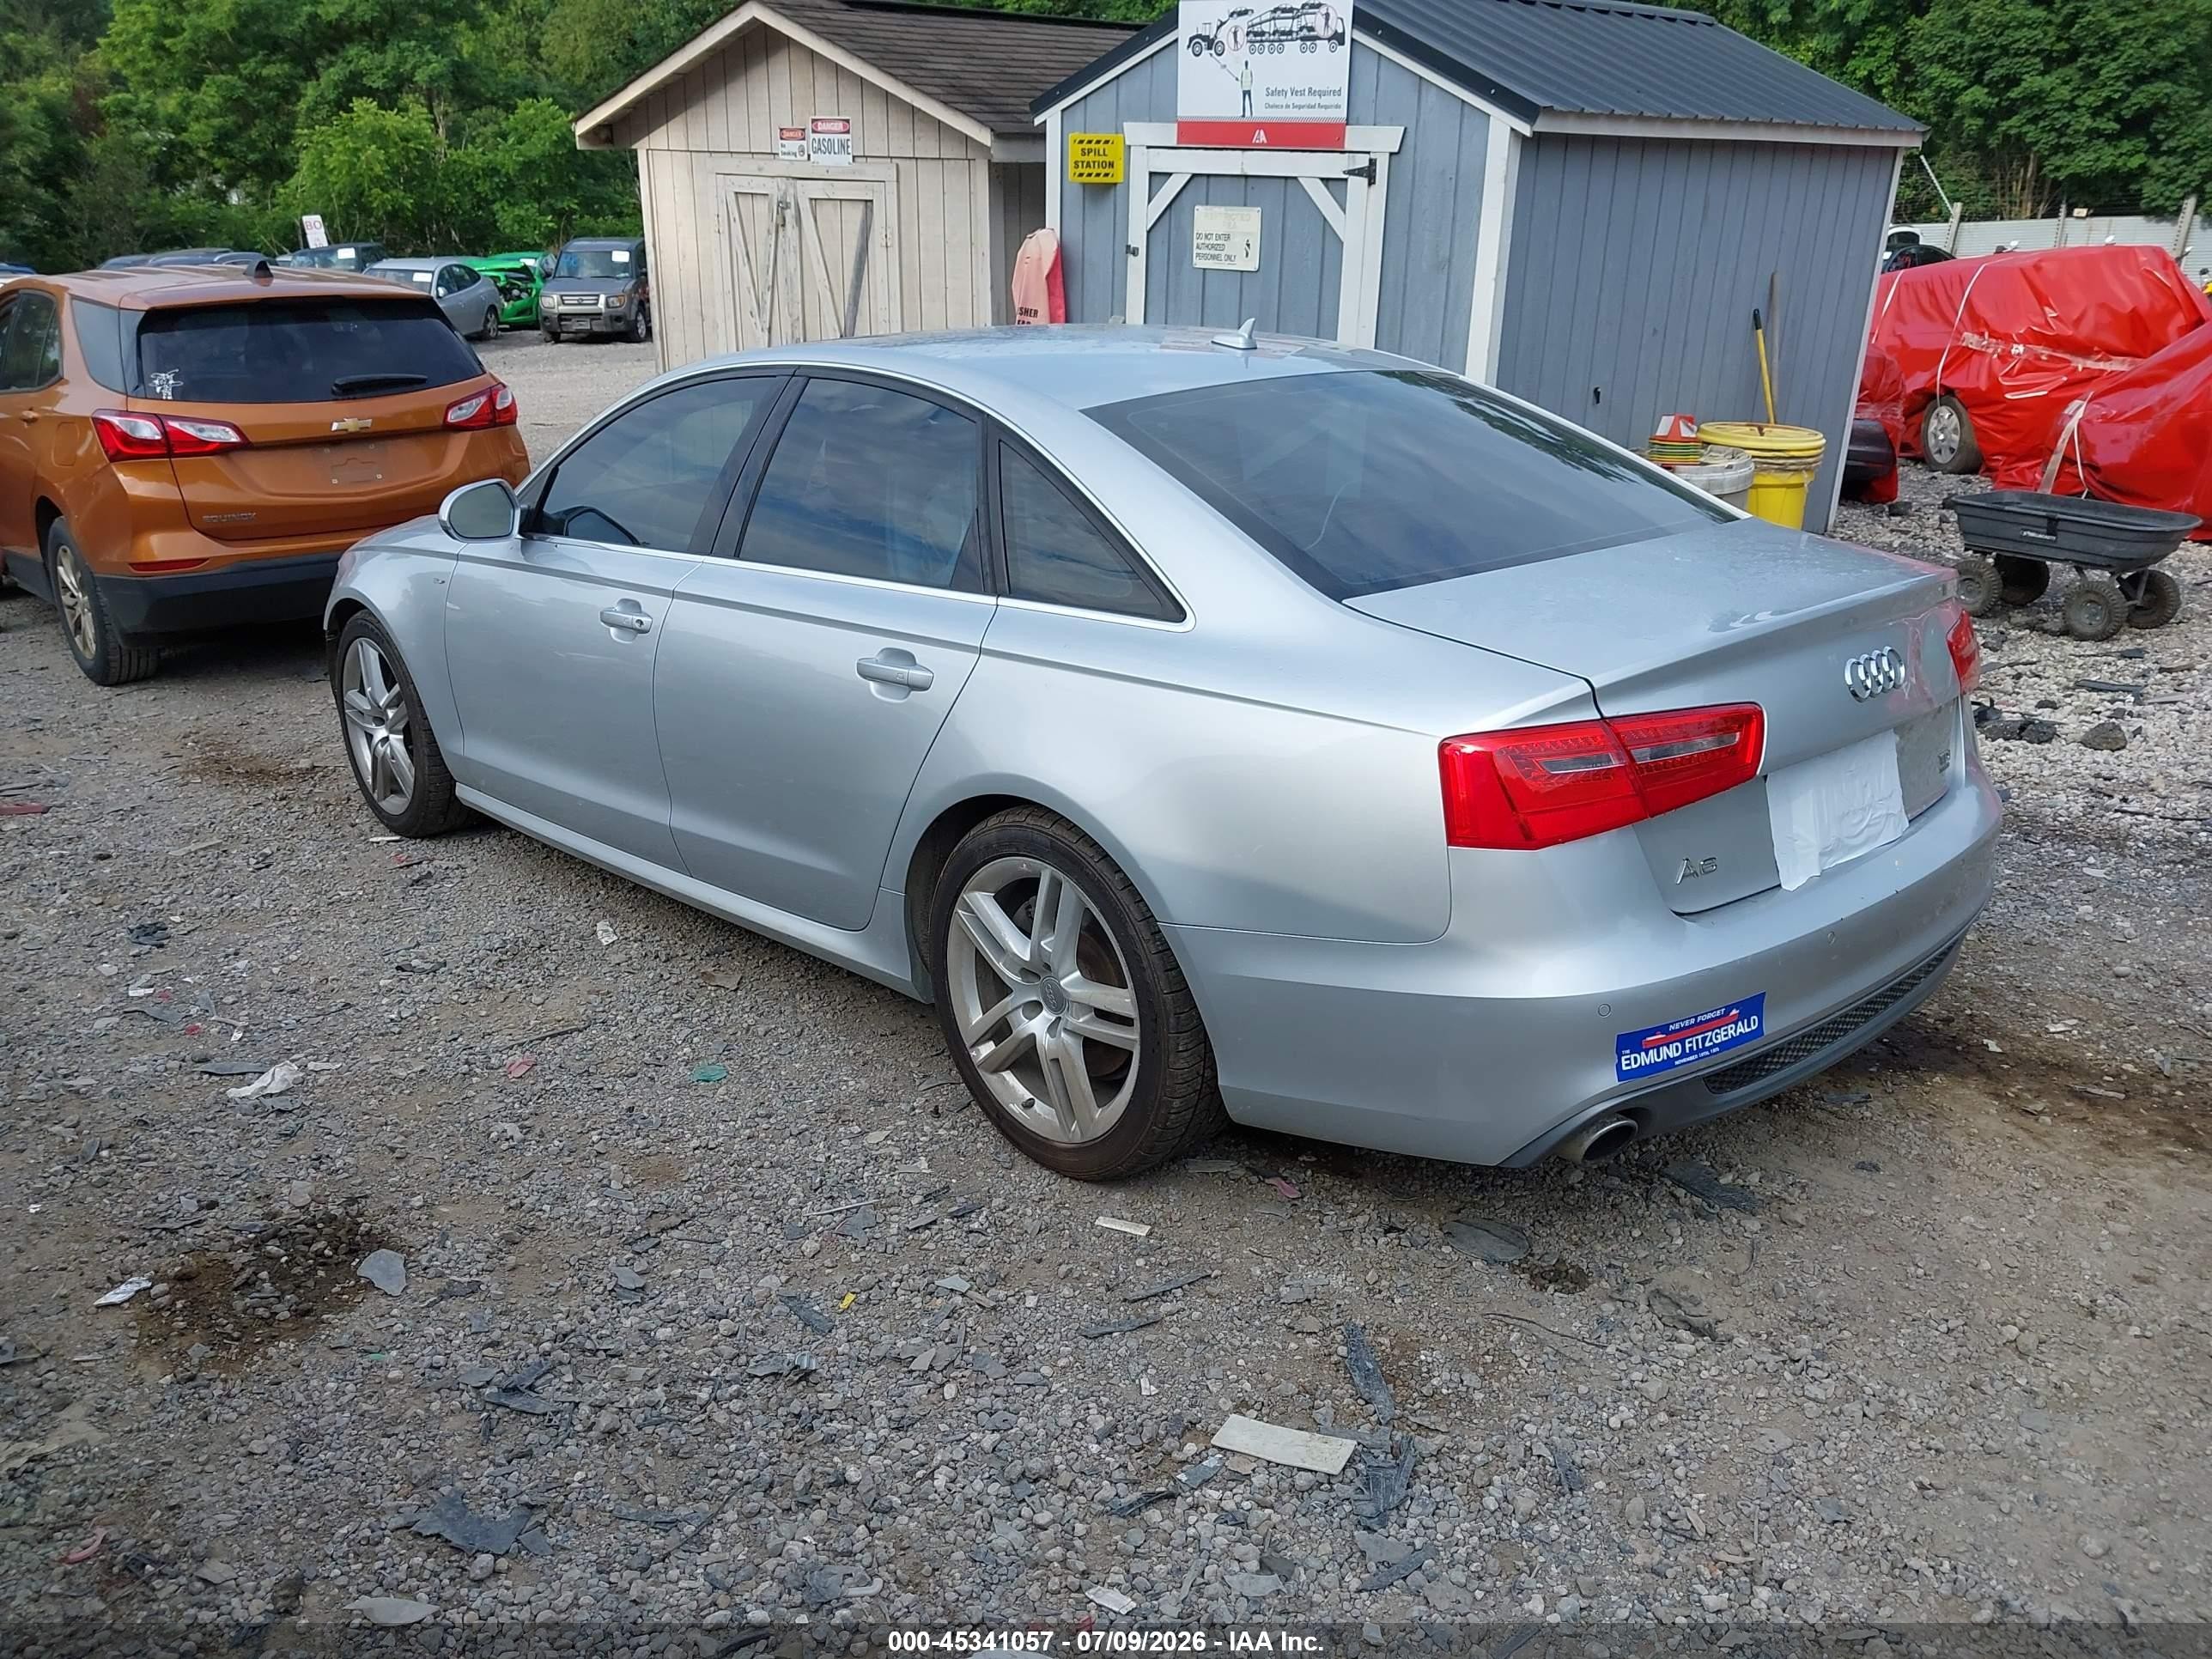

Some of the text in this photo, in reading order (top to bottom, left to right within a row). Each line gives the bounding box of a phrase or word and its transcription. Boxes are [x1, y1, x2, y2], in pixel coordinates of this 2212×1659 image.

[1265, 87, 1342, 99] Safety Vest Required
[811, 137, 851, 155] GASOLINE
[1080, 148, 1109, 156] SPILL
[1073, 160, 1115, 169] STATION
[1215, 233, 1231, 241] ENTER
[1195, 252, 1237, 262] PERSONNEL ONLY
[1676, 858, 1717, 884] A6
[1668, 1008, 1725, 1031] NEVER FORGET
[1621, 1016, 1759, 1071] EDMUND FITZGERALD
